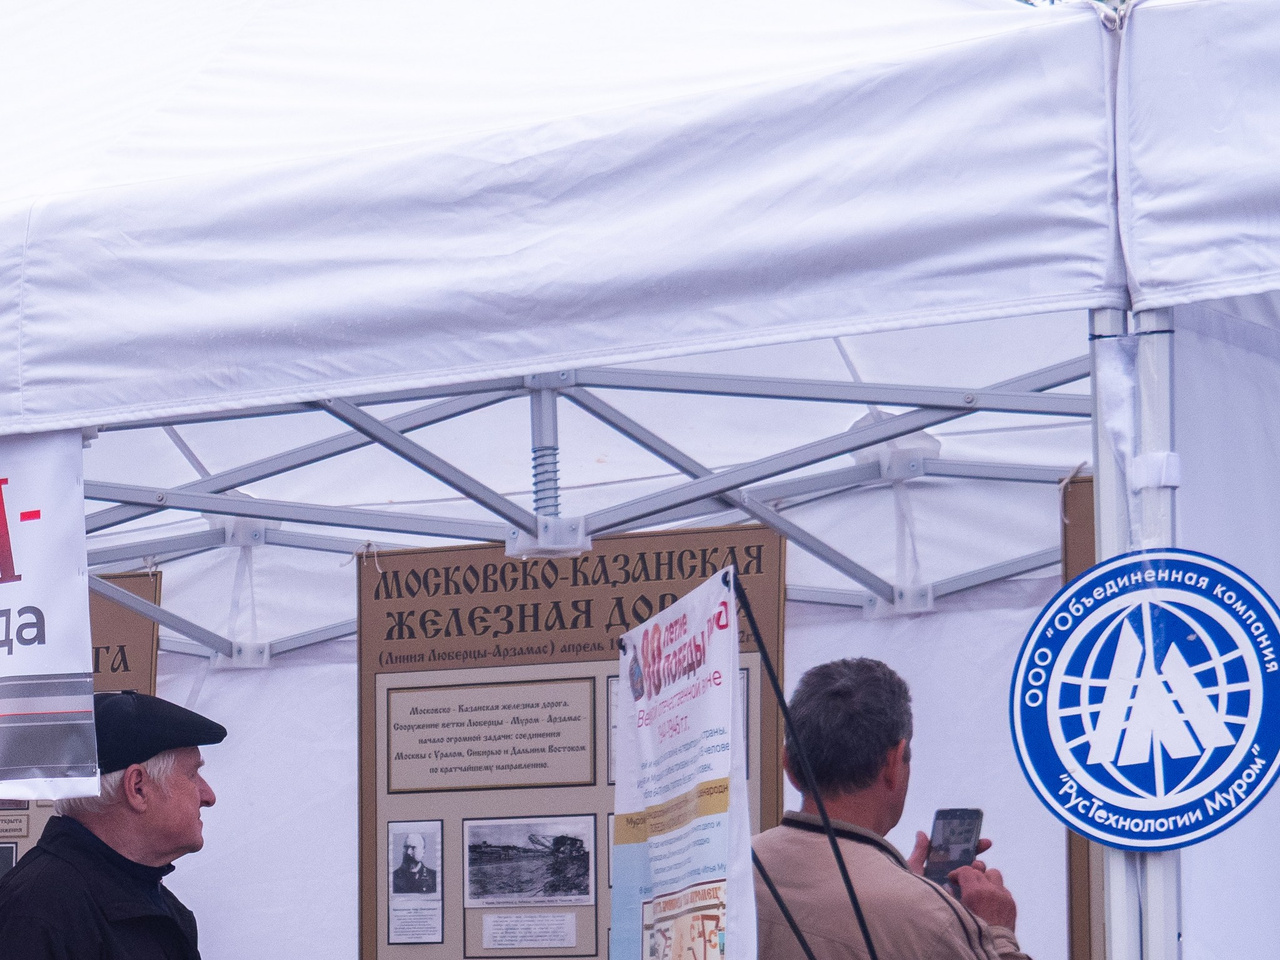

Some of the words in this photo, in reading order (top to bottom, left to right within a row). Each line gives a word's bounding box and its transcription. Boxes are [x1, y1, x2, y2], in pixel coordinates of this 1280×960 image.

[384, 599, 593, 641] ЖЕЛЕЗНАЯ
[560, 643, 604, 656] апрель
[1024, 646, 1052, 707] ООО
[1212, 583, 1279, 674] компания
